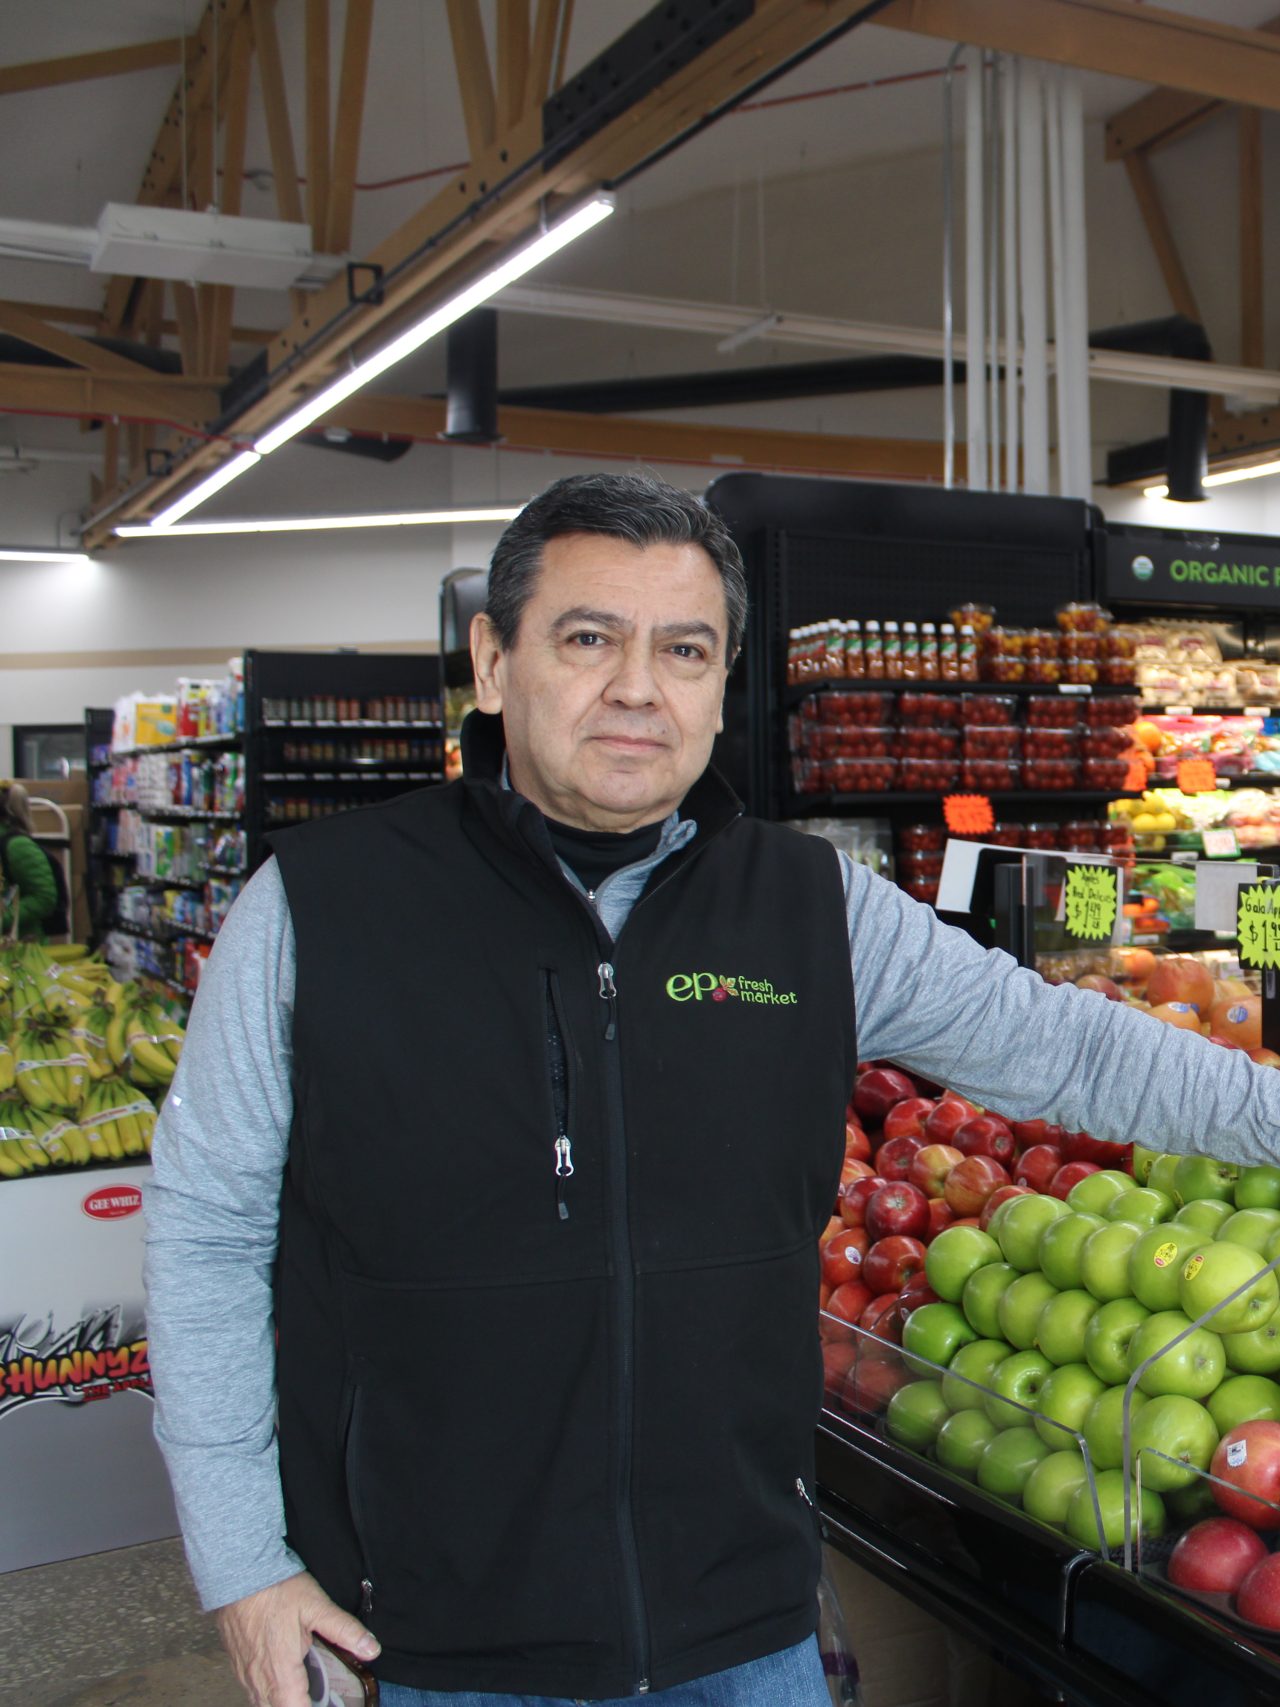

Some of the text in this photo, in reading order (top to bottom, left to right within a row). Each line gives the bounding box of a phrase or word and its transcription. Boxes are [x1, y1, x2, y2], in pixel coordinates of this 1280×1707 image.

[1170, 560, 1269, 587] ORGANIC
[1245, 897, 1265, 914] Gala
[666, 972, 719, 1001] ep
[738, 976, 773, 992] fresh
[741, 990, 798, 1004] market
[89, 1198, 110, 1211] GEE
